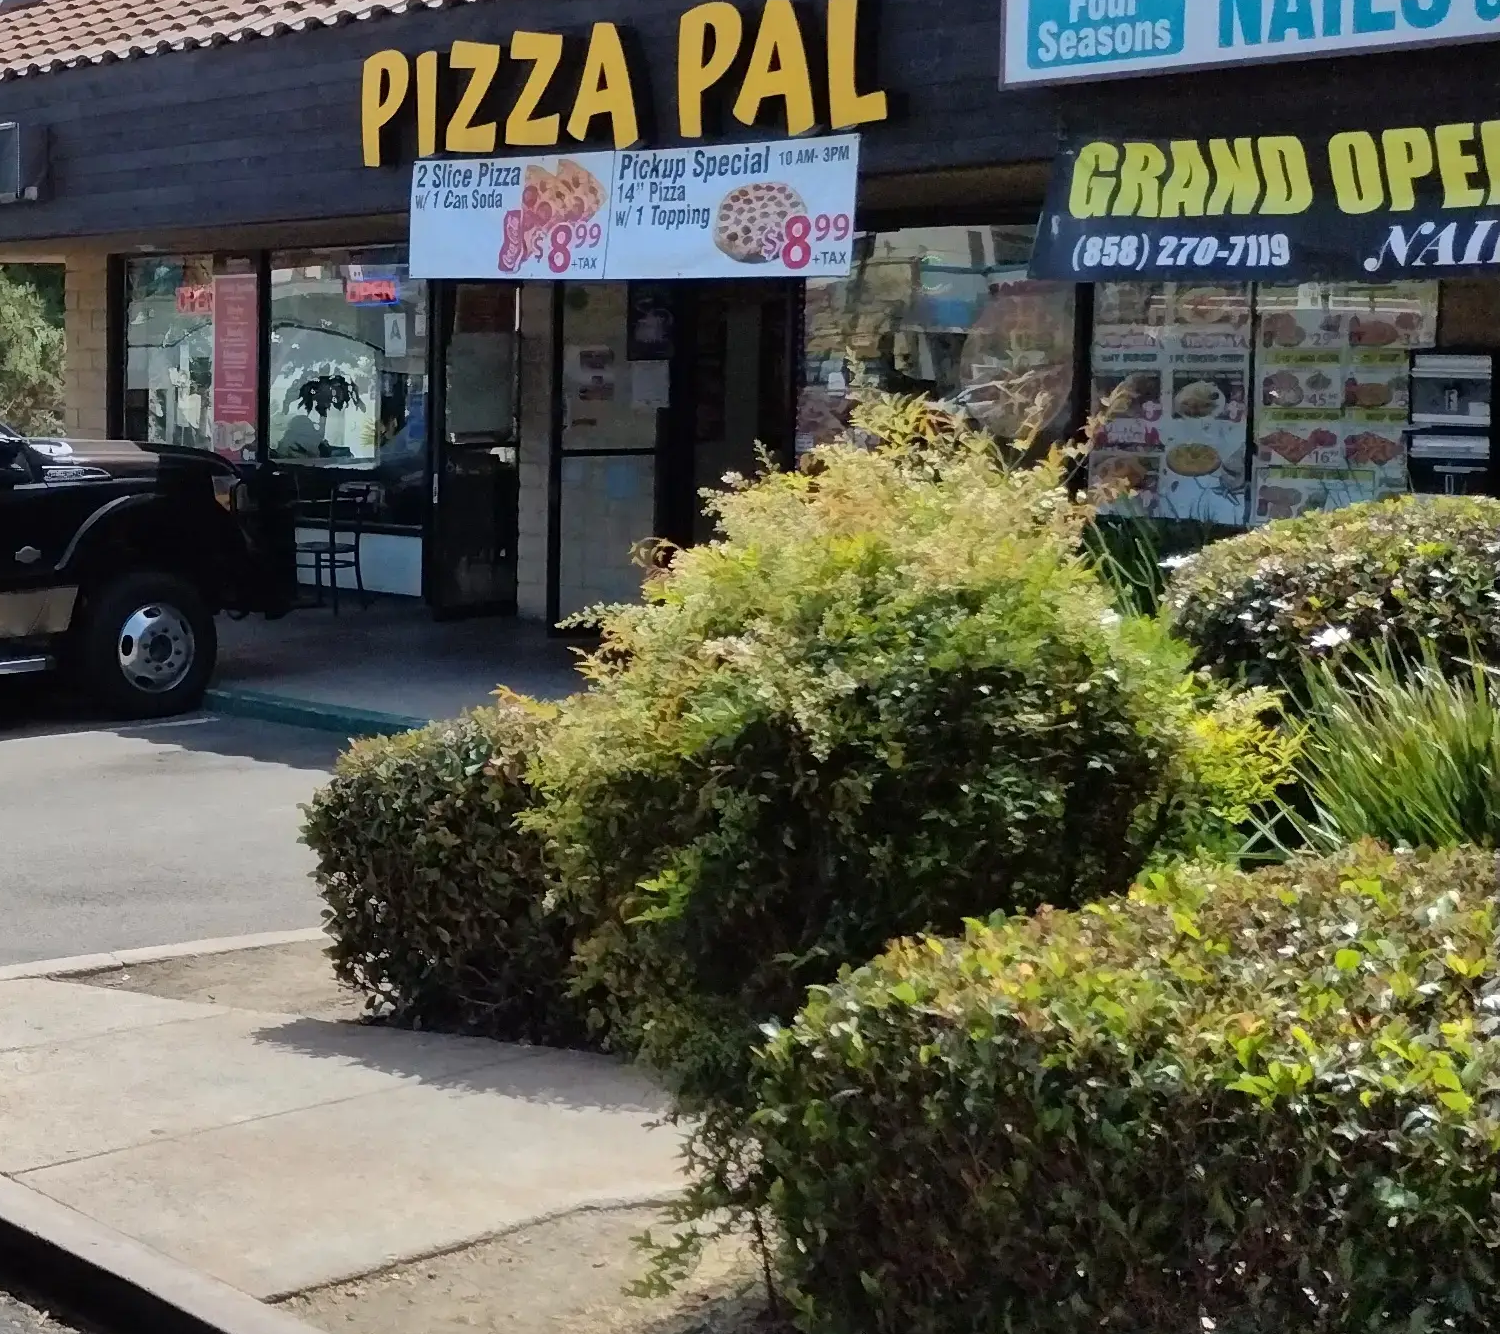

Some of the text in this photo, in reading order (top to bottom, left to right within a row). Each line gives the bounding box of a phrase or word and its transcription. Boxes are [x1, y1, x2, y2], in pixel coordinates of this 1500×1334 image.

[1037, 14, 1172, 62] Seasons
[361, 21, 639, 167] PIZZA
[416, 162, 522, 189] 2 Slice Pizza
[618, 153, 686, 184] Pickup
[692, 145, 771, 183] Special
[779, 150, 792, 166] 10
[1067, 135, 1313, 220] GRAND
[433, 190, 440, 205] 1
[443, 190, 468, 209] Can
[471, 189, 503, 210] Soda
[649, 181, 686, 203] Pizza
[615, 204, 711, 230] w/ 1 Topping
[1071, 233, 1291, 272] (858) 270-7119
[1363, 219, 1500, 272] NAI
